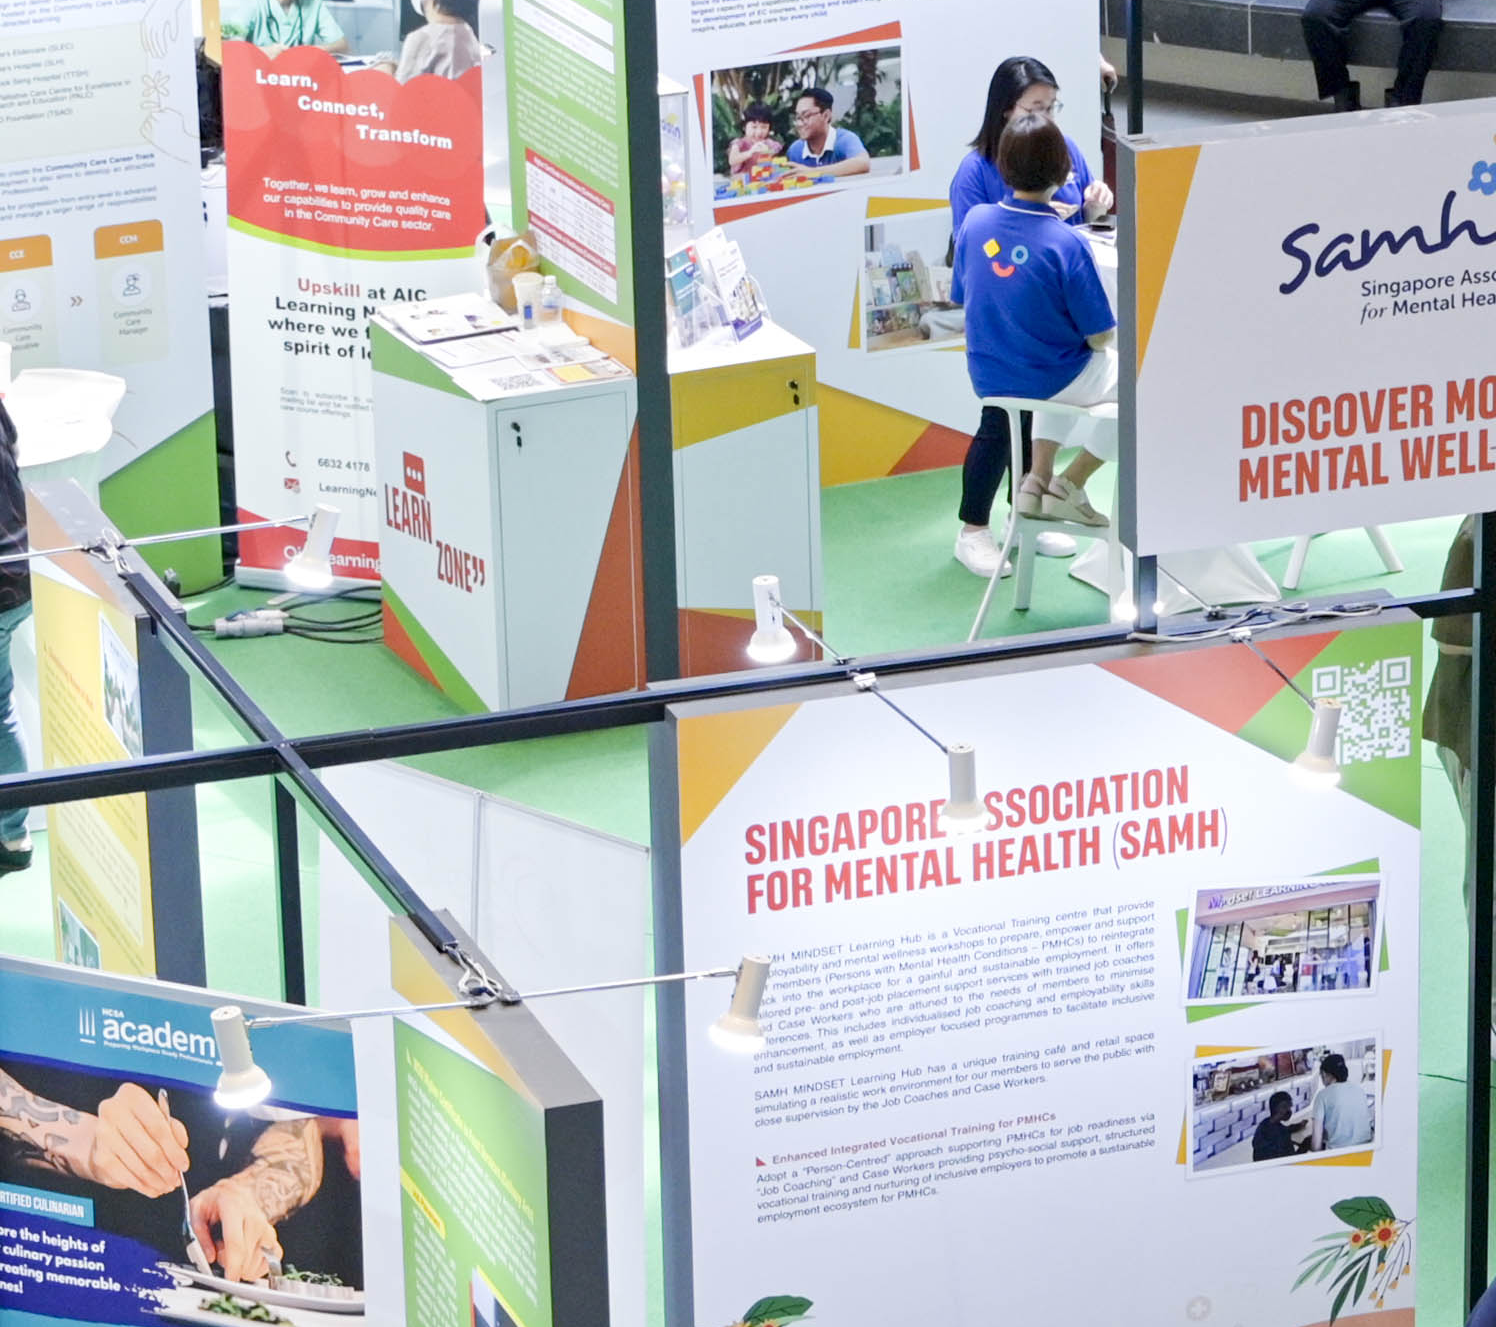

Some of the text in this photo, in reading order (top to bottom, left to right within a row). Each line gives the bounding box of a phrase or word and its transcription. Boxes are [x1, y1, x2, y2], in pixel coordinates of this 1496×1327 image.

[255, 68, 319, 92] Learn,
[297, 94, 386, 121] Connect,
[354, 123, 453, 150] Transform
[1359, 301, 1388, 326] for
[1392, 293, 1456, 317] Mental
[1360, 274, 1455, 299] Singapore
[1241, 383, 1434, 450] DISCOVER
[1238, 441, 1390, 503] MENTAL
[385, 482, 433, 545] LEARN
[745, 764, 1190, 867] SINGAPORE SSOCIATION
[746, 805, 1228, 915] FOR MENTAL HEALTH (SAMH)
